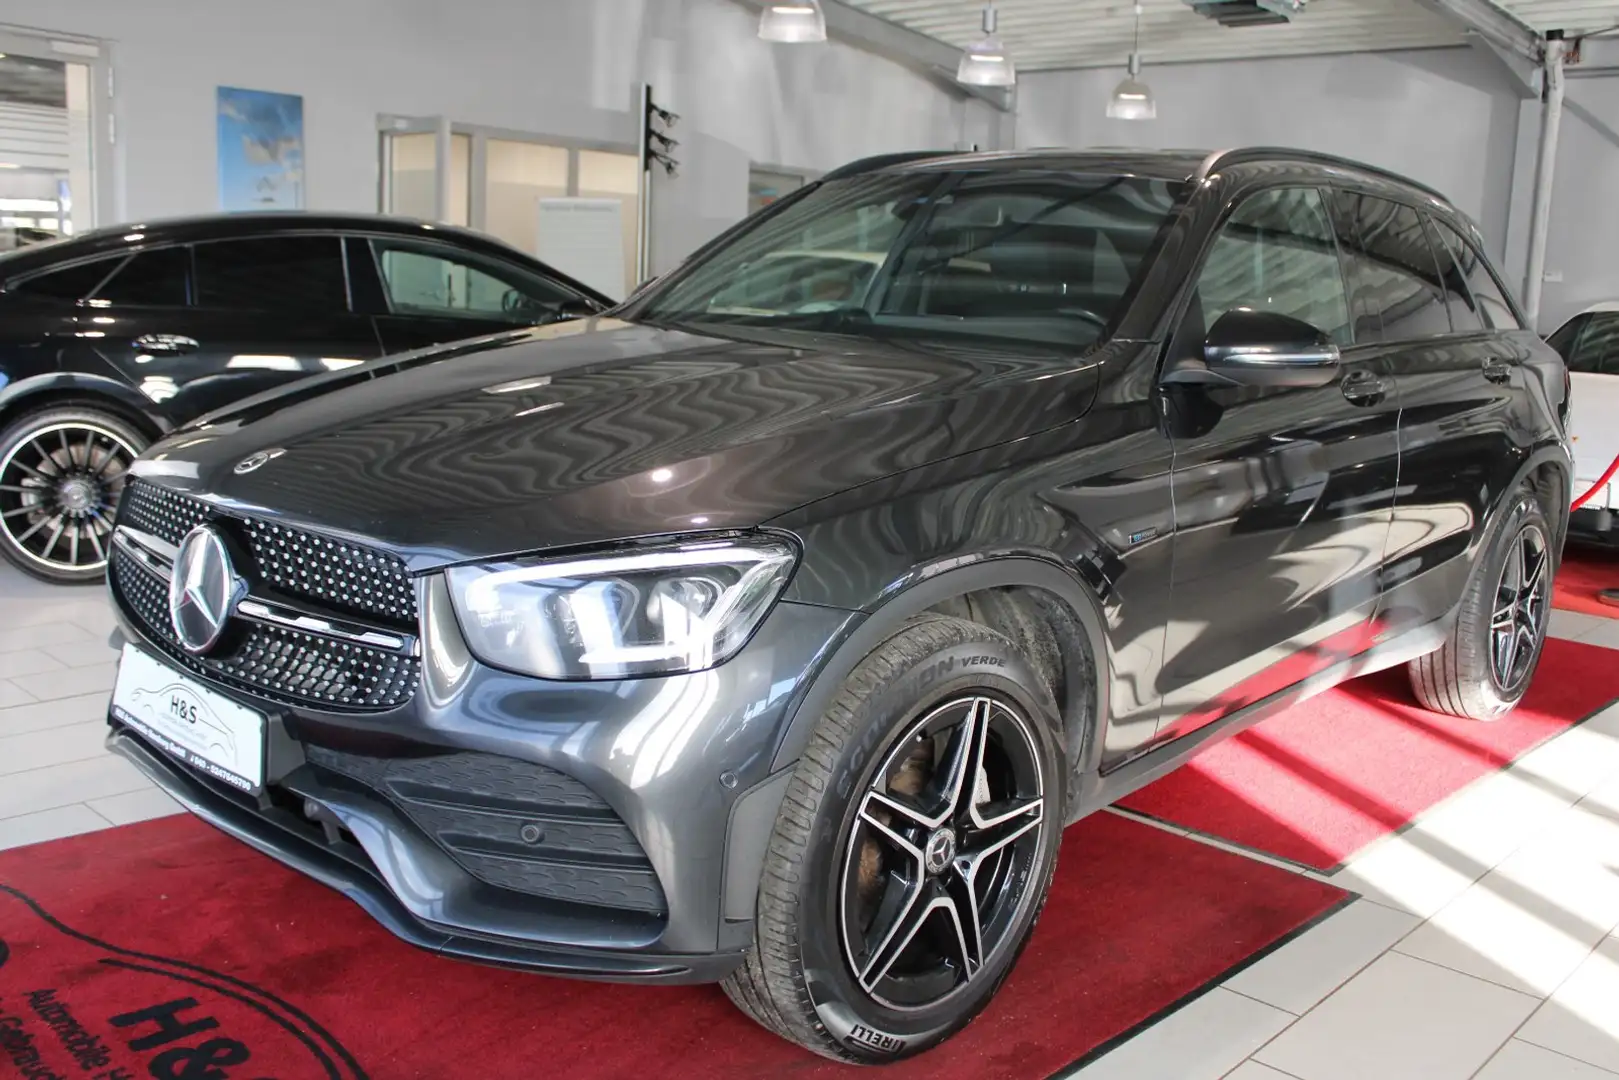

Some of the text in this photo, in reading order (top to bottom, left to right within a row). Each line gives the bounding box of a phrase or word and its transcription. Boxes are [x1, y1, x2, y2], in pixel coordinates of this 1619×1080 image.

[960, 655, 1008, 669] VERDE
[170, 694, 198, 725] H&S
[22, 988, 112, 1071] Automobile
[108, 996, 280, 1080] H&
[844, 1023, 907, 1055] PIRELLI
